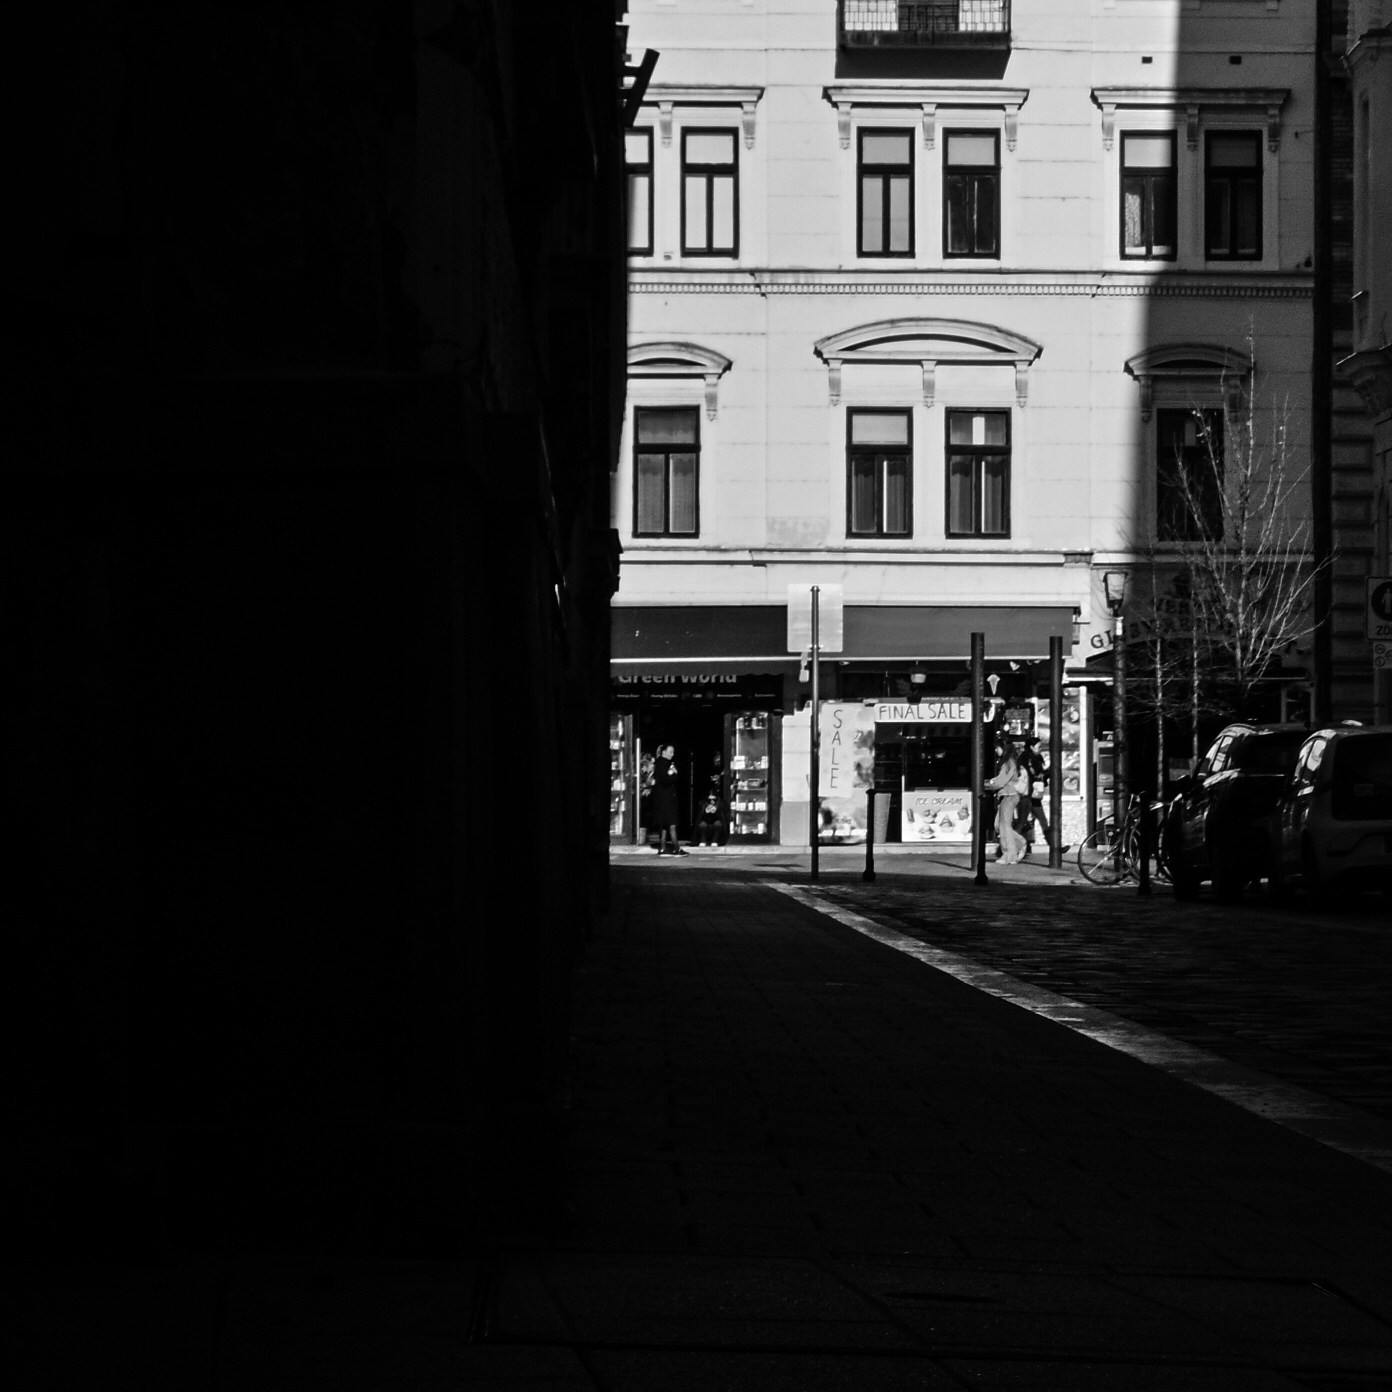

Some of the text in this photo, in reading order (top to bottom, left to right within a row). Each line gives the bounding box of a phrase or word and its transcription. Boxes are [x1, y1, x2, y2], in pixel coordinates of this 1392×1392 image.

[619, 674, 738, 684] Green World
[879, 703, 966, 720] FINAL SALE
[830, 709, 844, 789] SALE
